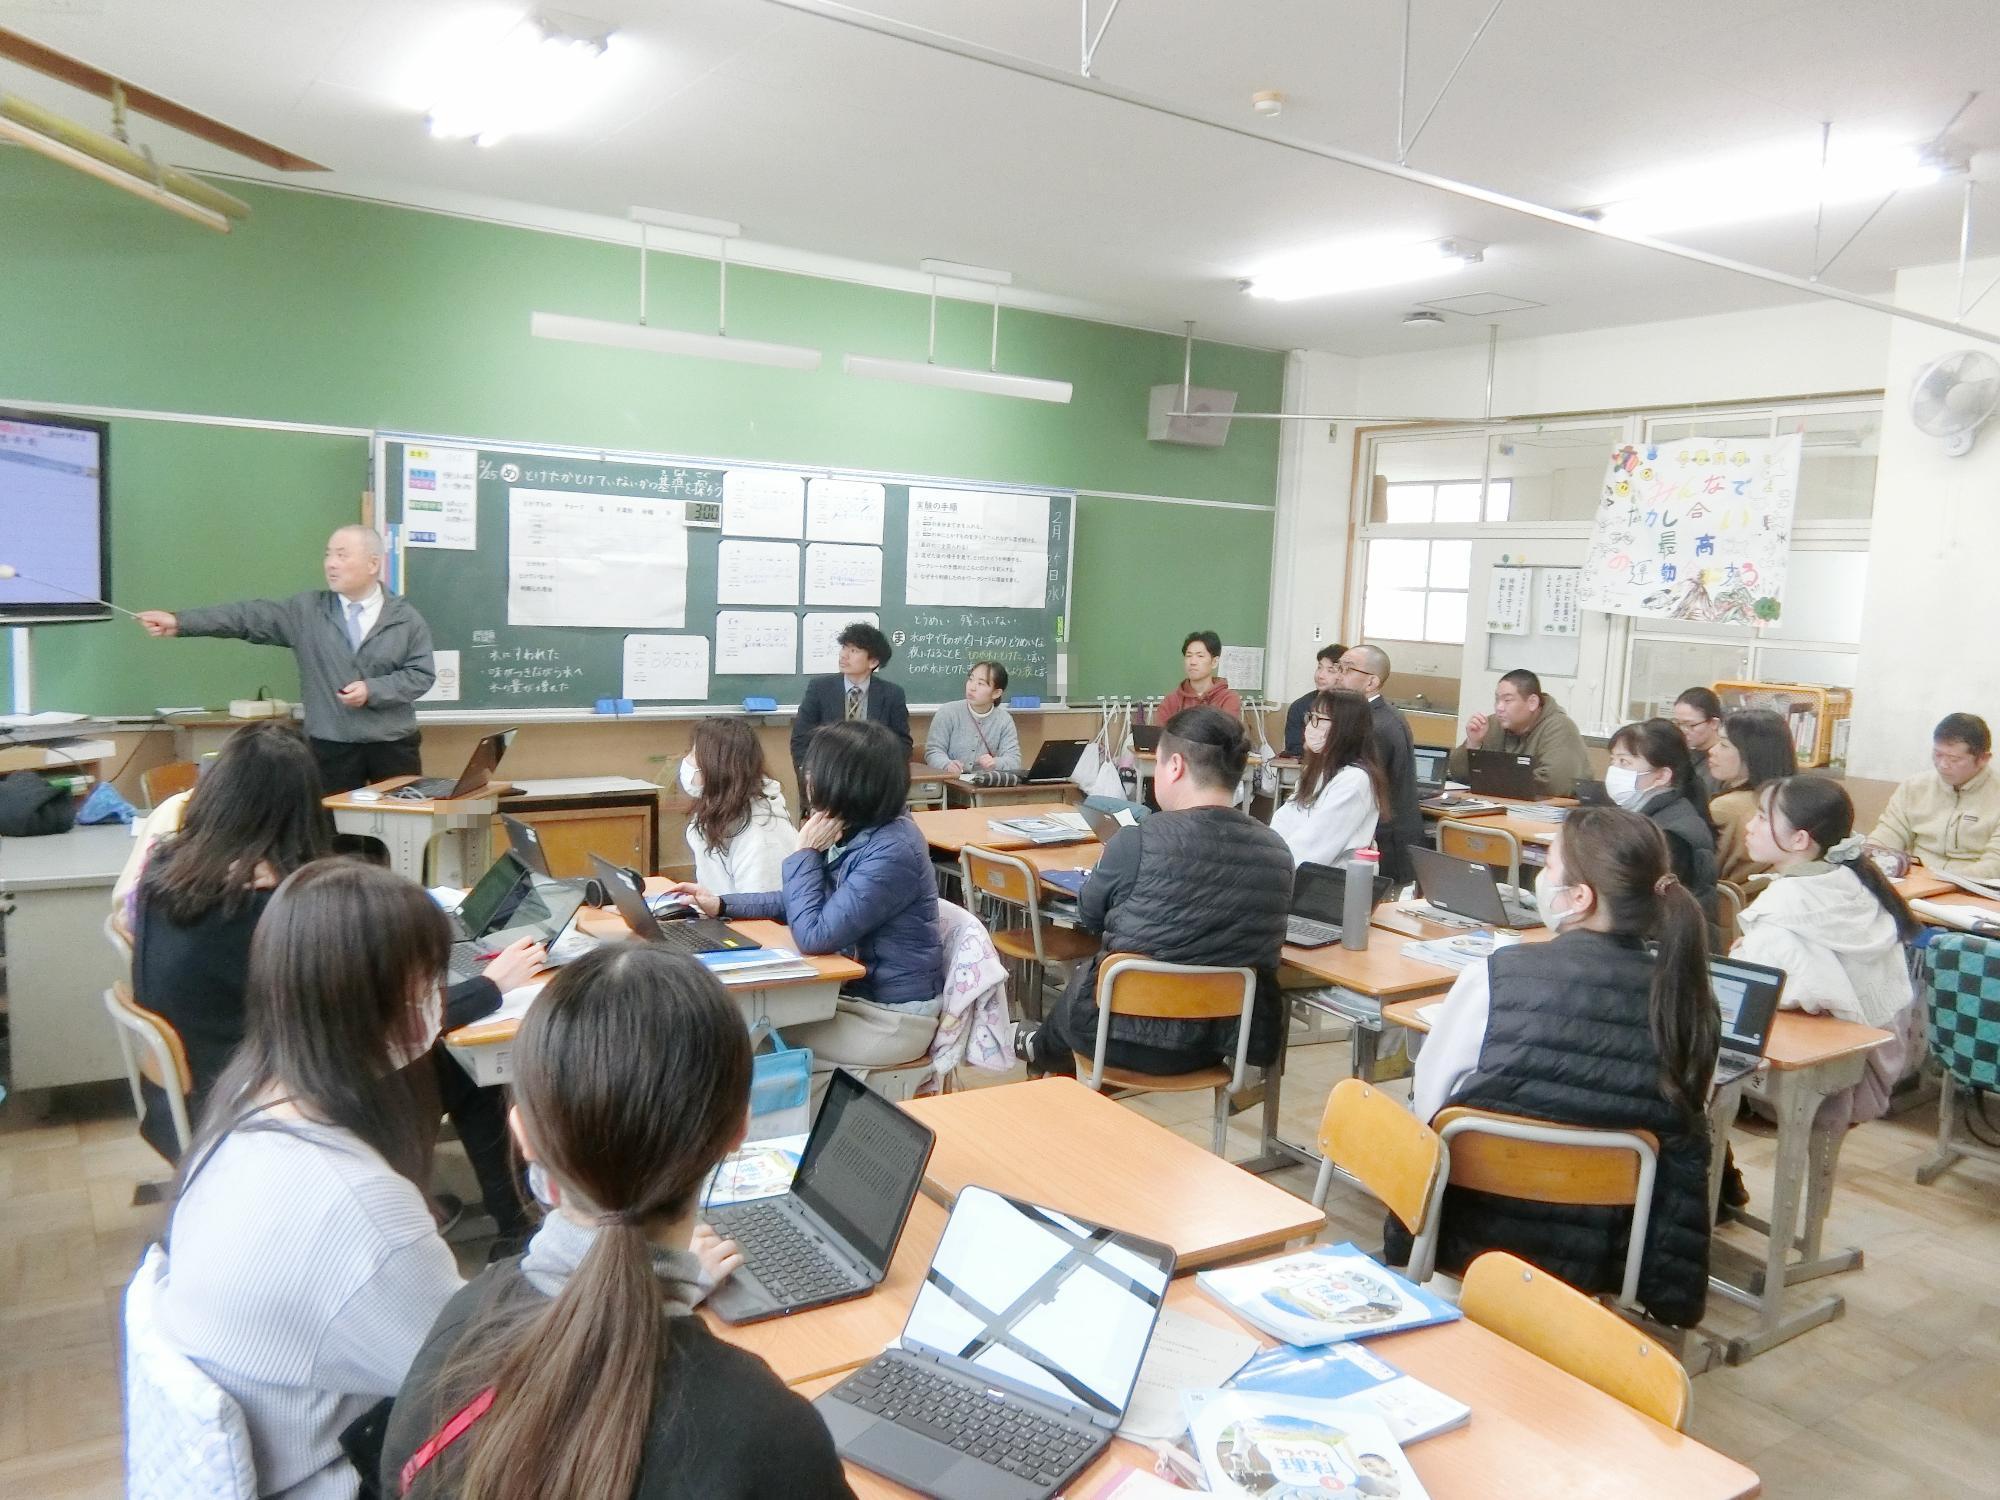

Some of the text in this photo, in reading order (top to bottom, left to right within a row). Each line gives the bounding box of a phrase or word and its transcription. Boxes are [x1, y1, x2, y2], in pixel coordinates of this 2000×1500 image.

[916, 501, 958, 512] 実験の手順
[1658, 530, 1716, 560] 最高
